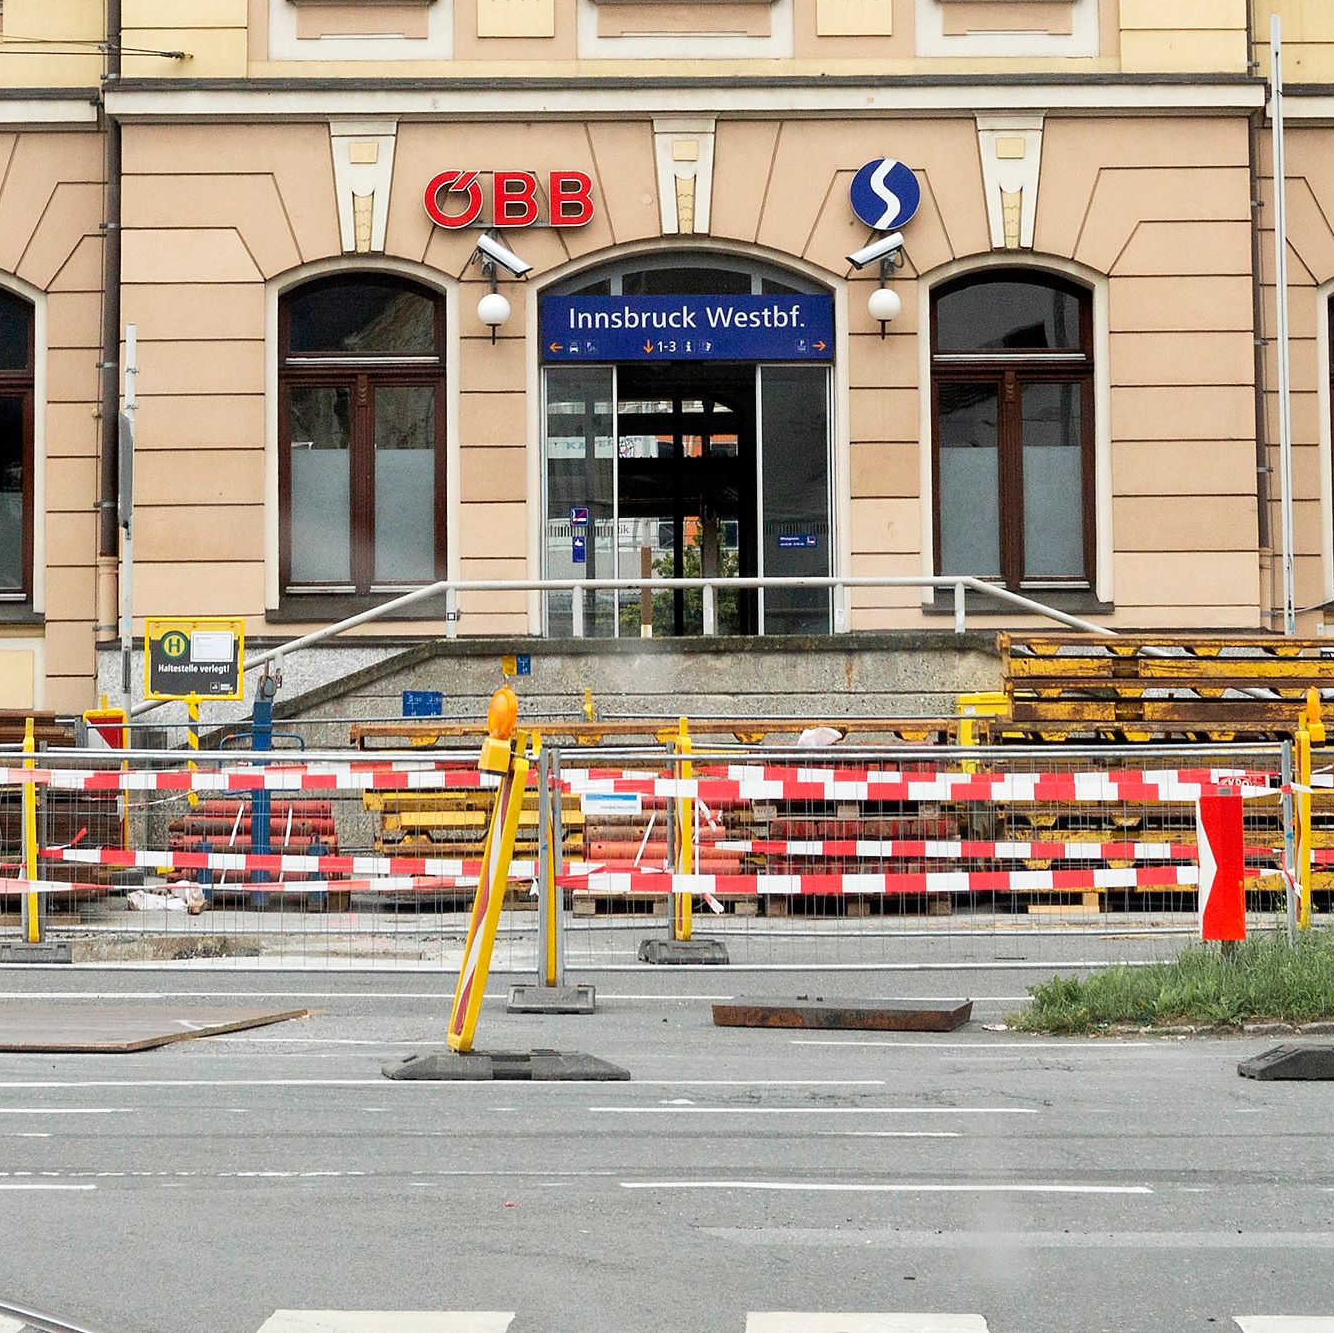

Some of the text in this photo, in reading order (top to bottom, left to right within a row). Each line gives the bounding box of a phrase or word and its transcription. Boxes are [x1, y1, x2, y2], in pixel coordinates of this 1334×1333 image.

[424, 170, 594, 230] ÖBB
[569, 305, 805, 329] Innsbruck Westbf.
[657, 340, 677, 352] 1-3
[168, 638, 181, 653] H
[158, 663, 230, 675] Haltestelle verlegt!
